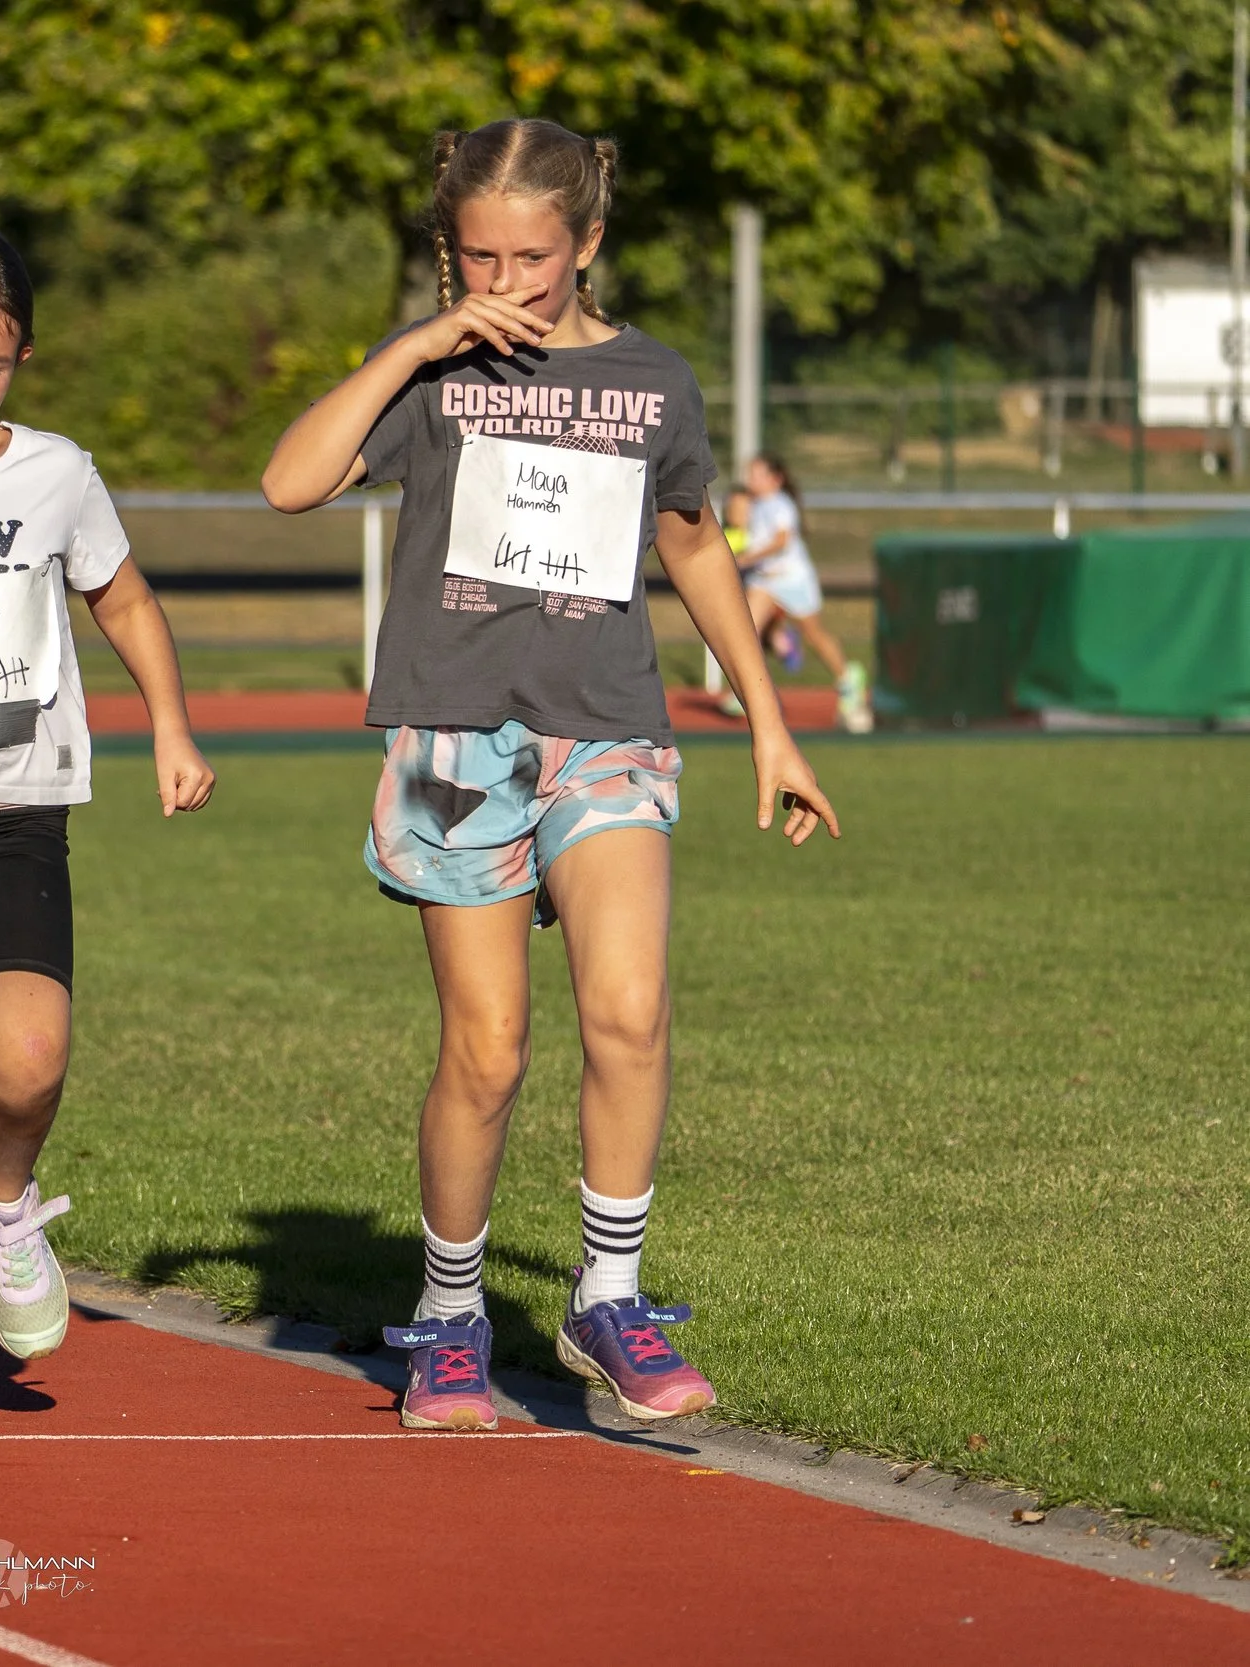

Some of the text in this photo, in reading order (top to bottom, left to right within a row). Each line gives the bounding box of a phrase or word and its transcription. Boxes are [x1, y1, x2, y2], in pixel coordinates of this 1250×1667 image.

[442, 382, 664, 427] COSMIC LOVE
[458, 418, 644, 443] WOLRD TOUR
[516, 462, 568, 501] Maya
[507, 494, 560, 513] Hammen
[459, 602, 472, 611] SAN
[568, 601, 582, 610] SAN
[564, 609, 586, 620] MIAMI
[420, 1333, 438, 1342] LICO
